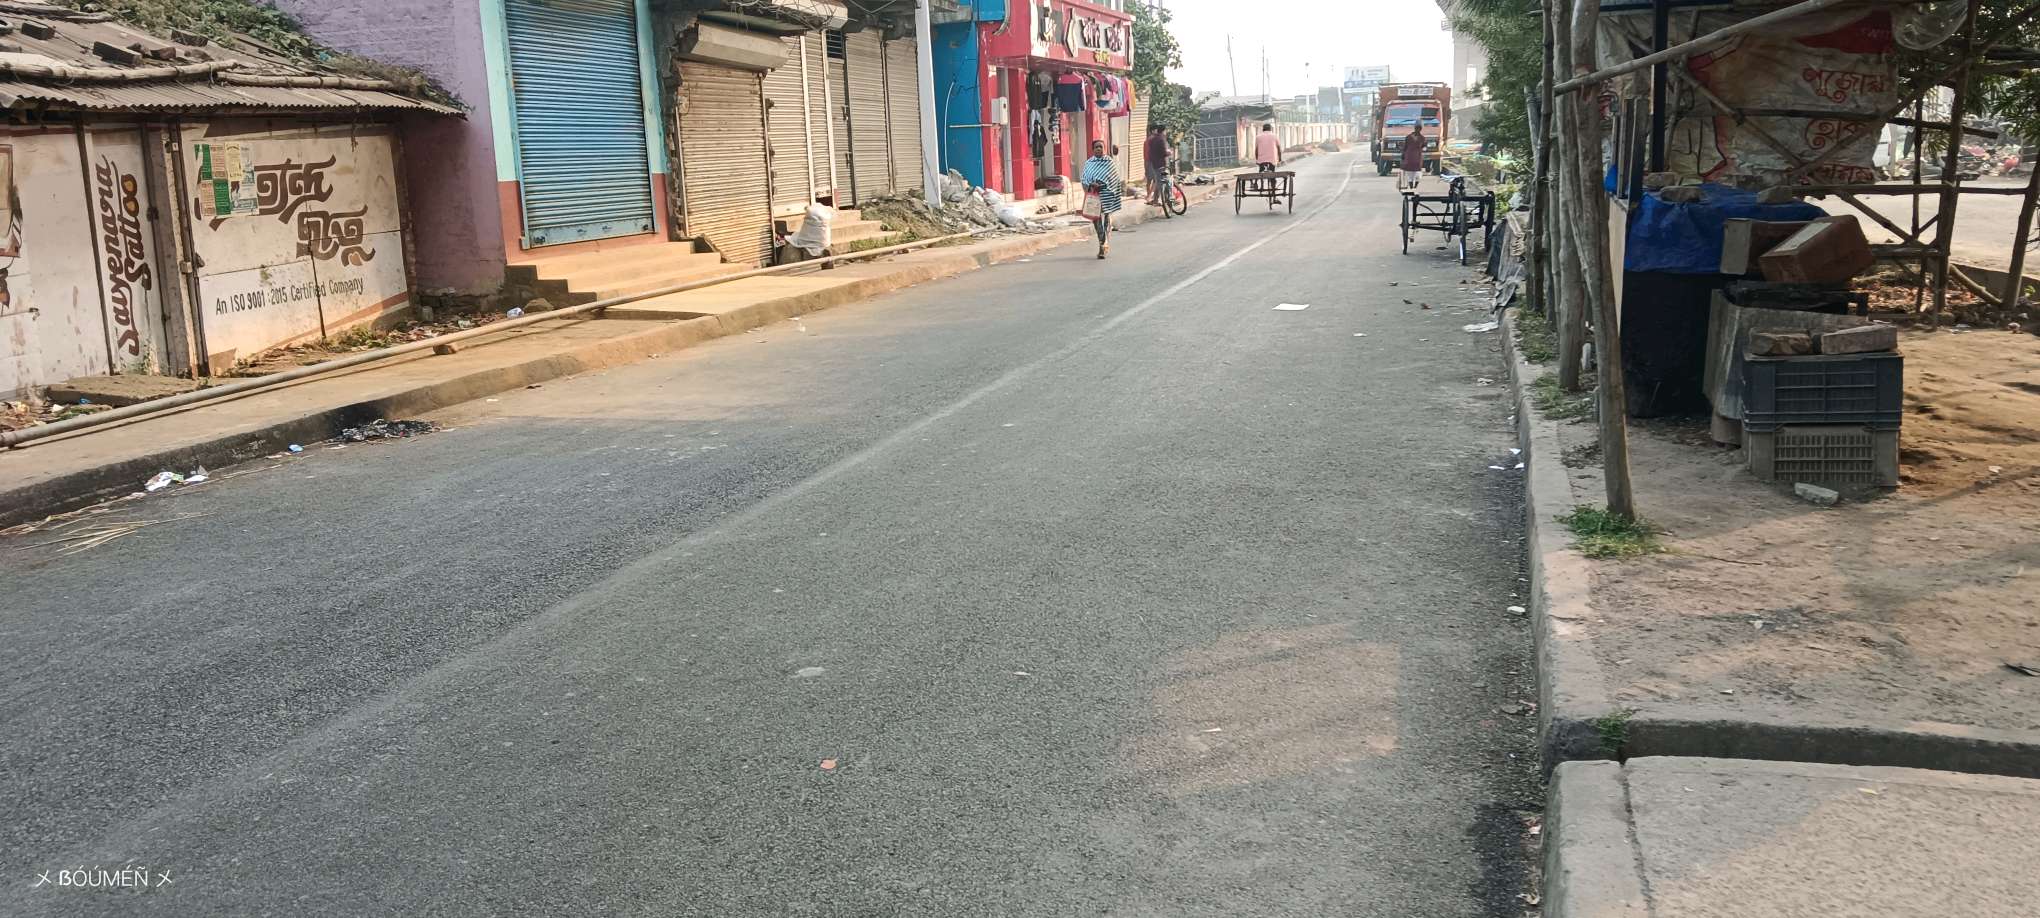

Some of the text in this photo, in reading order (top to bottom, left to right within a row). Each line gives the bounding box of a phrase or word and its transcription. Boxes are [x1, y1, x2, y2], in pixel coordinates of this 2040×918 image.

[111, 161, 153, 291] Sattoo
[215, 297, 228, 315] An
[230, 293, 246, 313] ISO
[247, 289, 266, 310] 9001
[290, 282, 327, 302] Certified
[329, 277, 364, 296] Company
